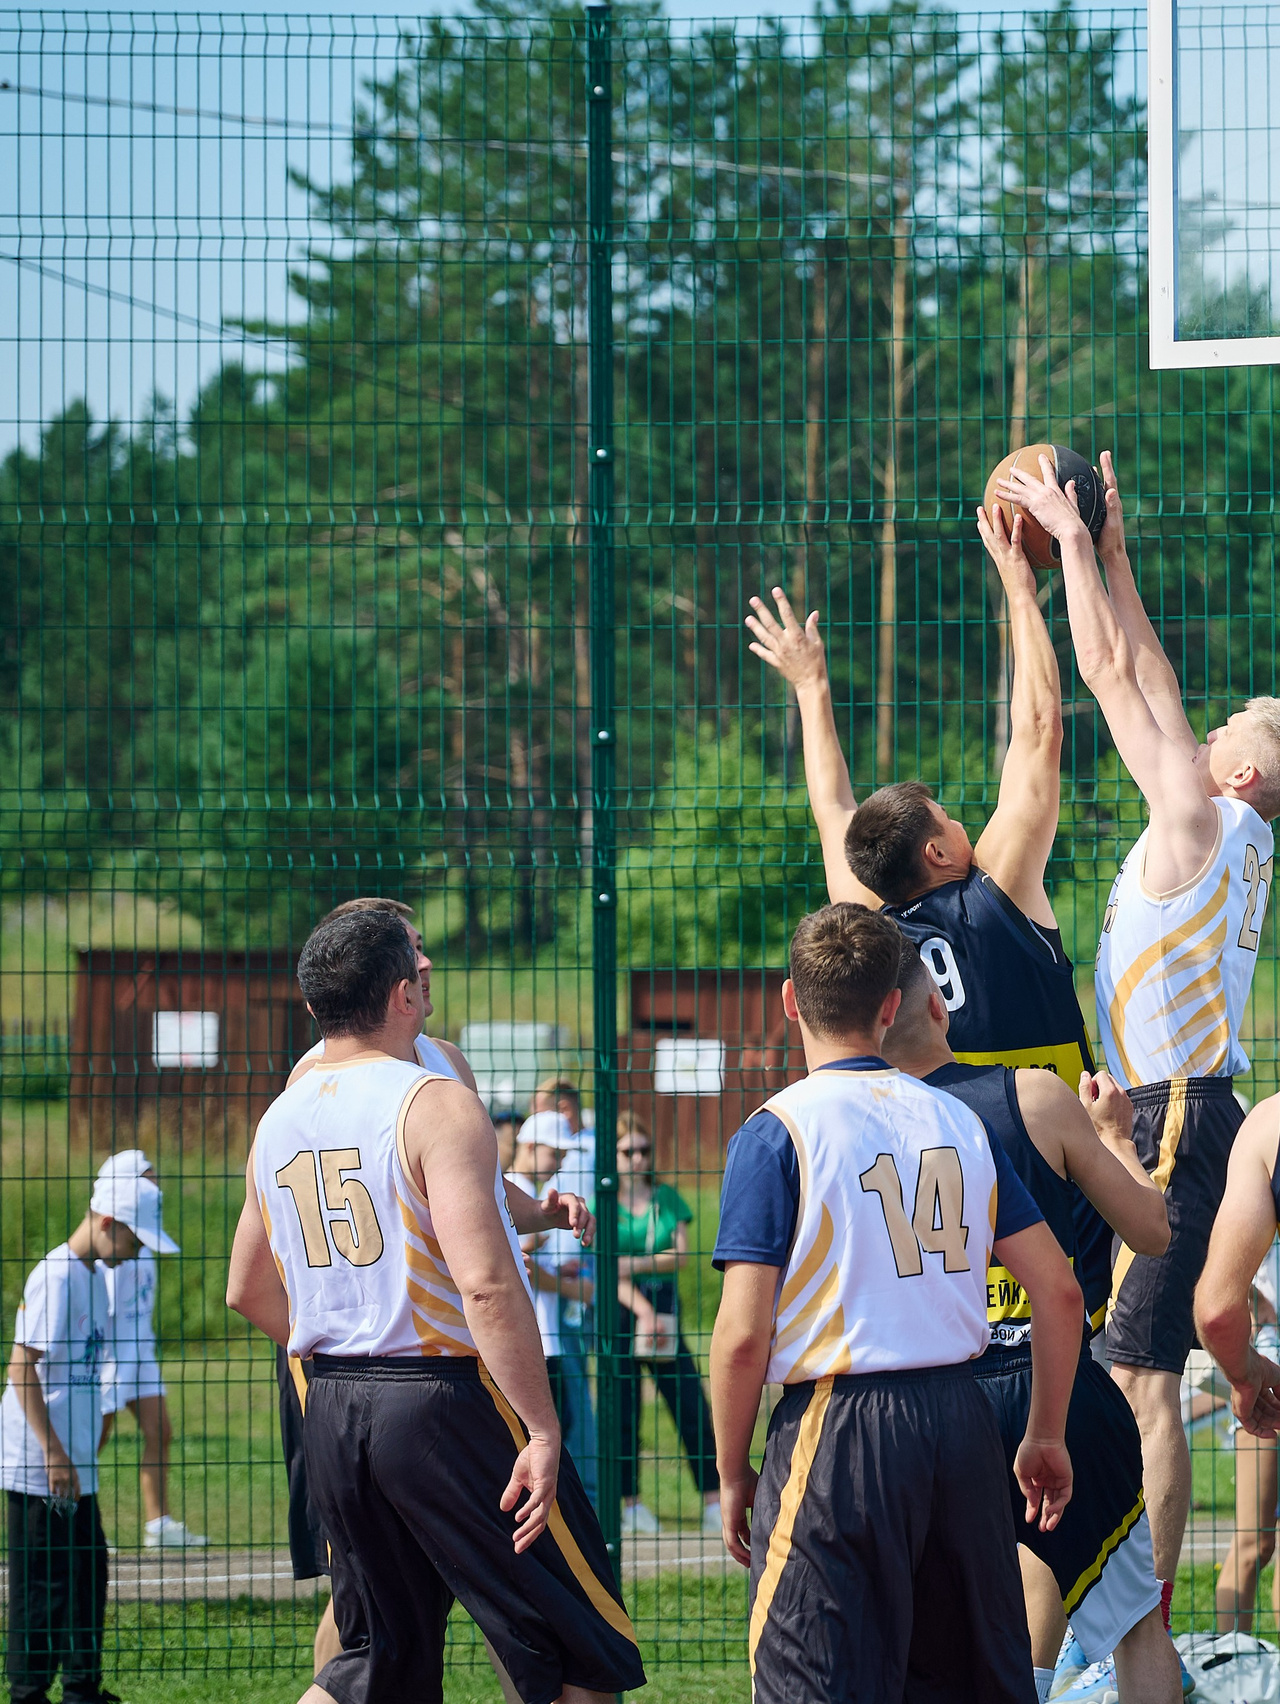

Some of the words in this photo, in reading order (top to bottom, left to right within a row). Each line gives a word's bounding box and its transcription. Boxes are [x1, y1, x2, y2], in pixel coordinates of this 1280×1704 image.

[920, 937, 965, 1012] 9
[276, 1148, 384, 1267] 15
[859, 1146, 970, 1278] 14
[986, 1279, 1030, 1308] ЕЙК.
[991, 1327, 1015, 1341] ВОЙ
